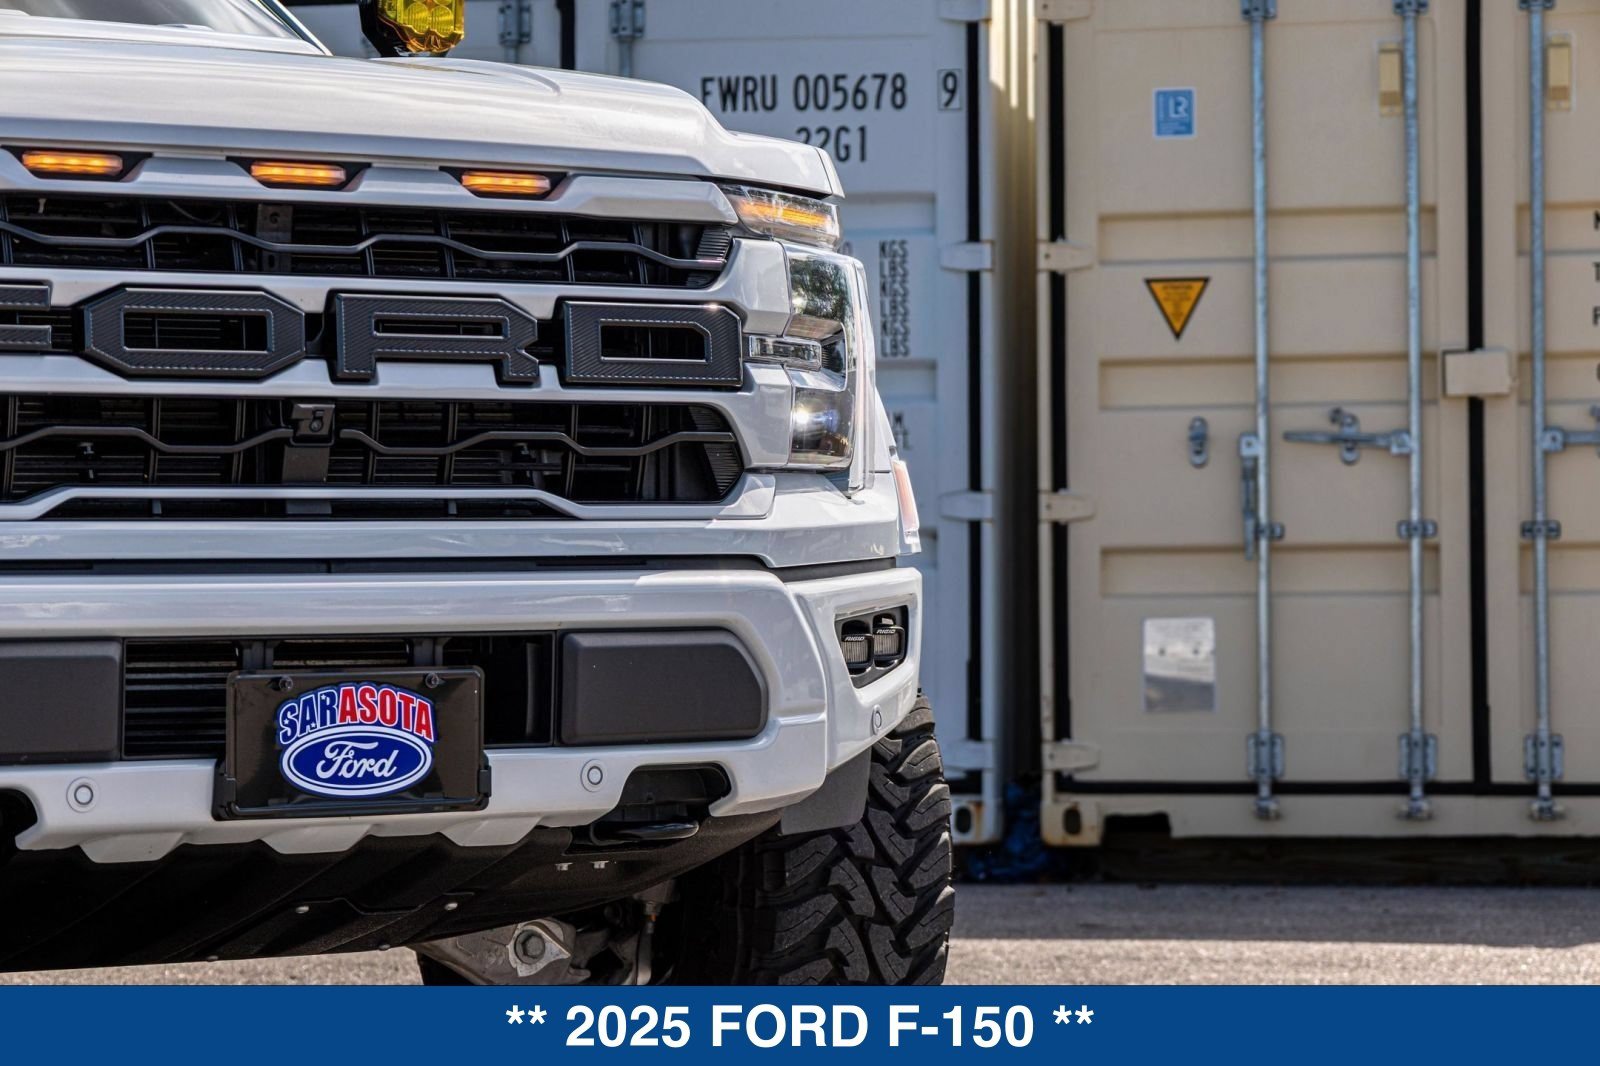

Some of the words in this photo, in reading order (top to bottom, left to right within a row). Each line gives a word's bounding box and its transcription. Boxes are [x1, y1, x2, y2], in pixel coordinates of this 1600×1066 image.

[793, 73, 907, 111] 005678
[942, 72, 959, 107] 9
[0, 285, 743, 387] ORD
[279, 686, 434, 744] SARASOTA
[316, 741, 398, 779] Ford
